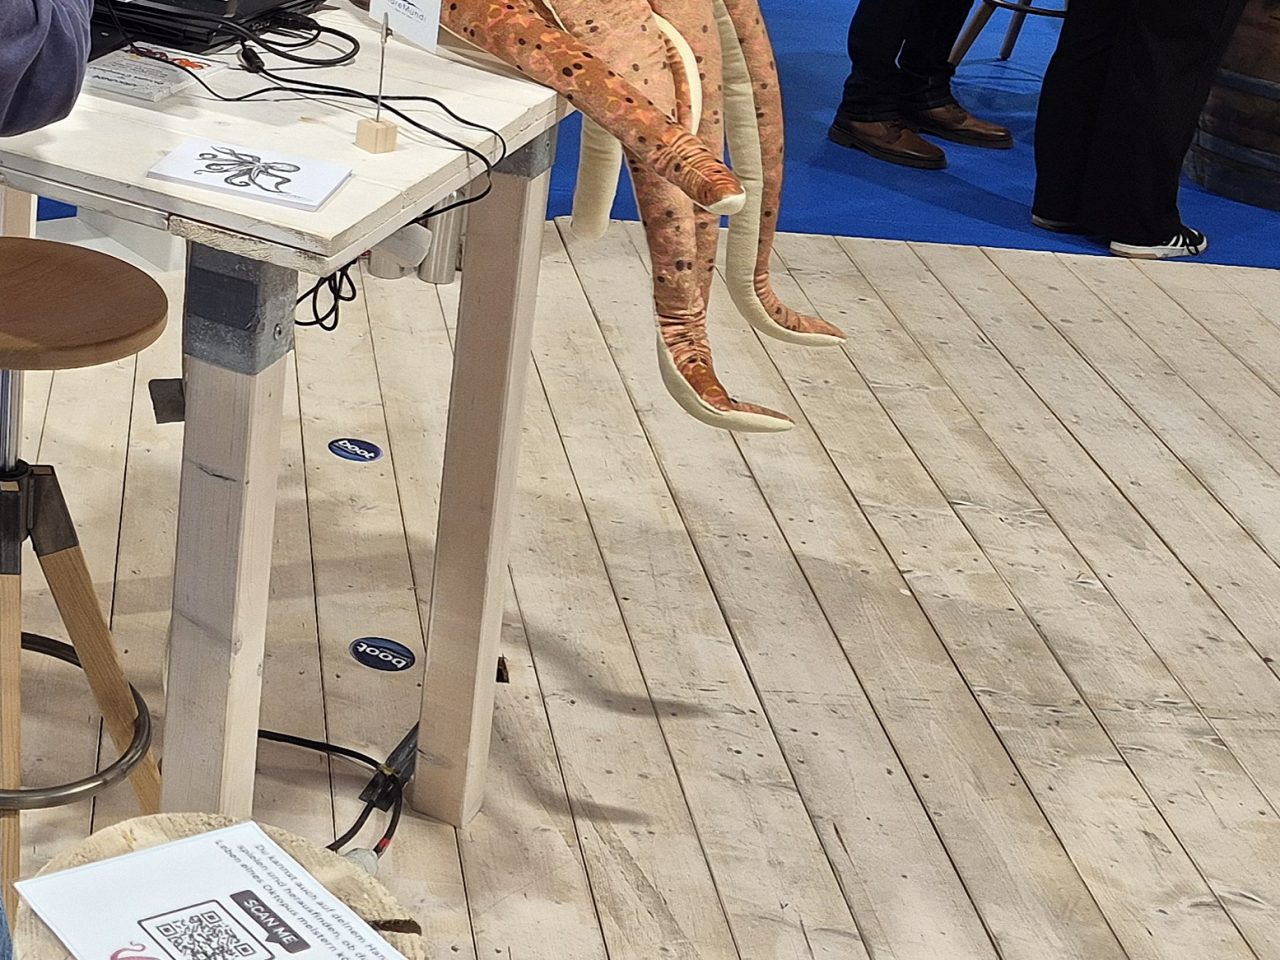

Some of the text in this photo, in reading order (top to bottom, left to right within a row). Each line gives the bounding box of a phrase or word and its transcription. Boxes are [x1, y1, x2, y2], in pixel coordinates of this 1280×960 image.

[338, 439, 376, 460] boot
[357, 642, 408, 669] boot
[215, 839, 242, 863] Leben
[240, 863, 264, 884] eines
[263, 884, 298, 916] Oktopus
[297, 917, 337, 952] meistern
[237, 845, 269, 871] spielen
[267, 871, 288, 888] und
[283, 887, 341, 940] herausfinden,
[341, 940, 357, 952] ob
[243, 899, 299, 944] SCAN ME
[255, 844, 270, 856] Du
[268, 855, 298, 881] kannst
[295, 881, 318, 901] auch
[316, 900, 337, 914] auf
[331, 913, 366, 944] deinem
